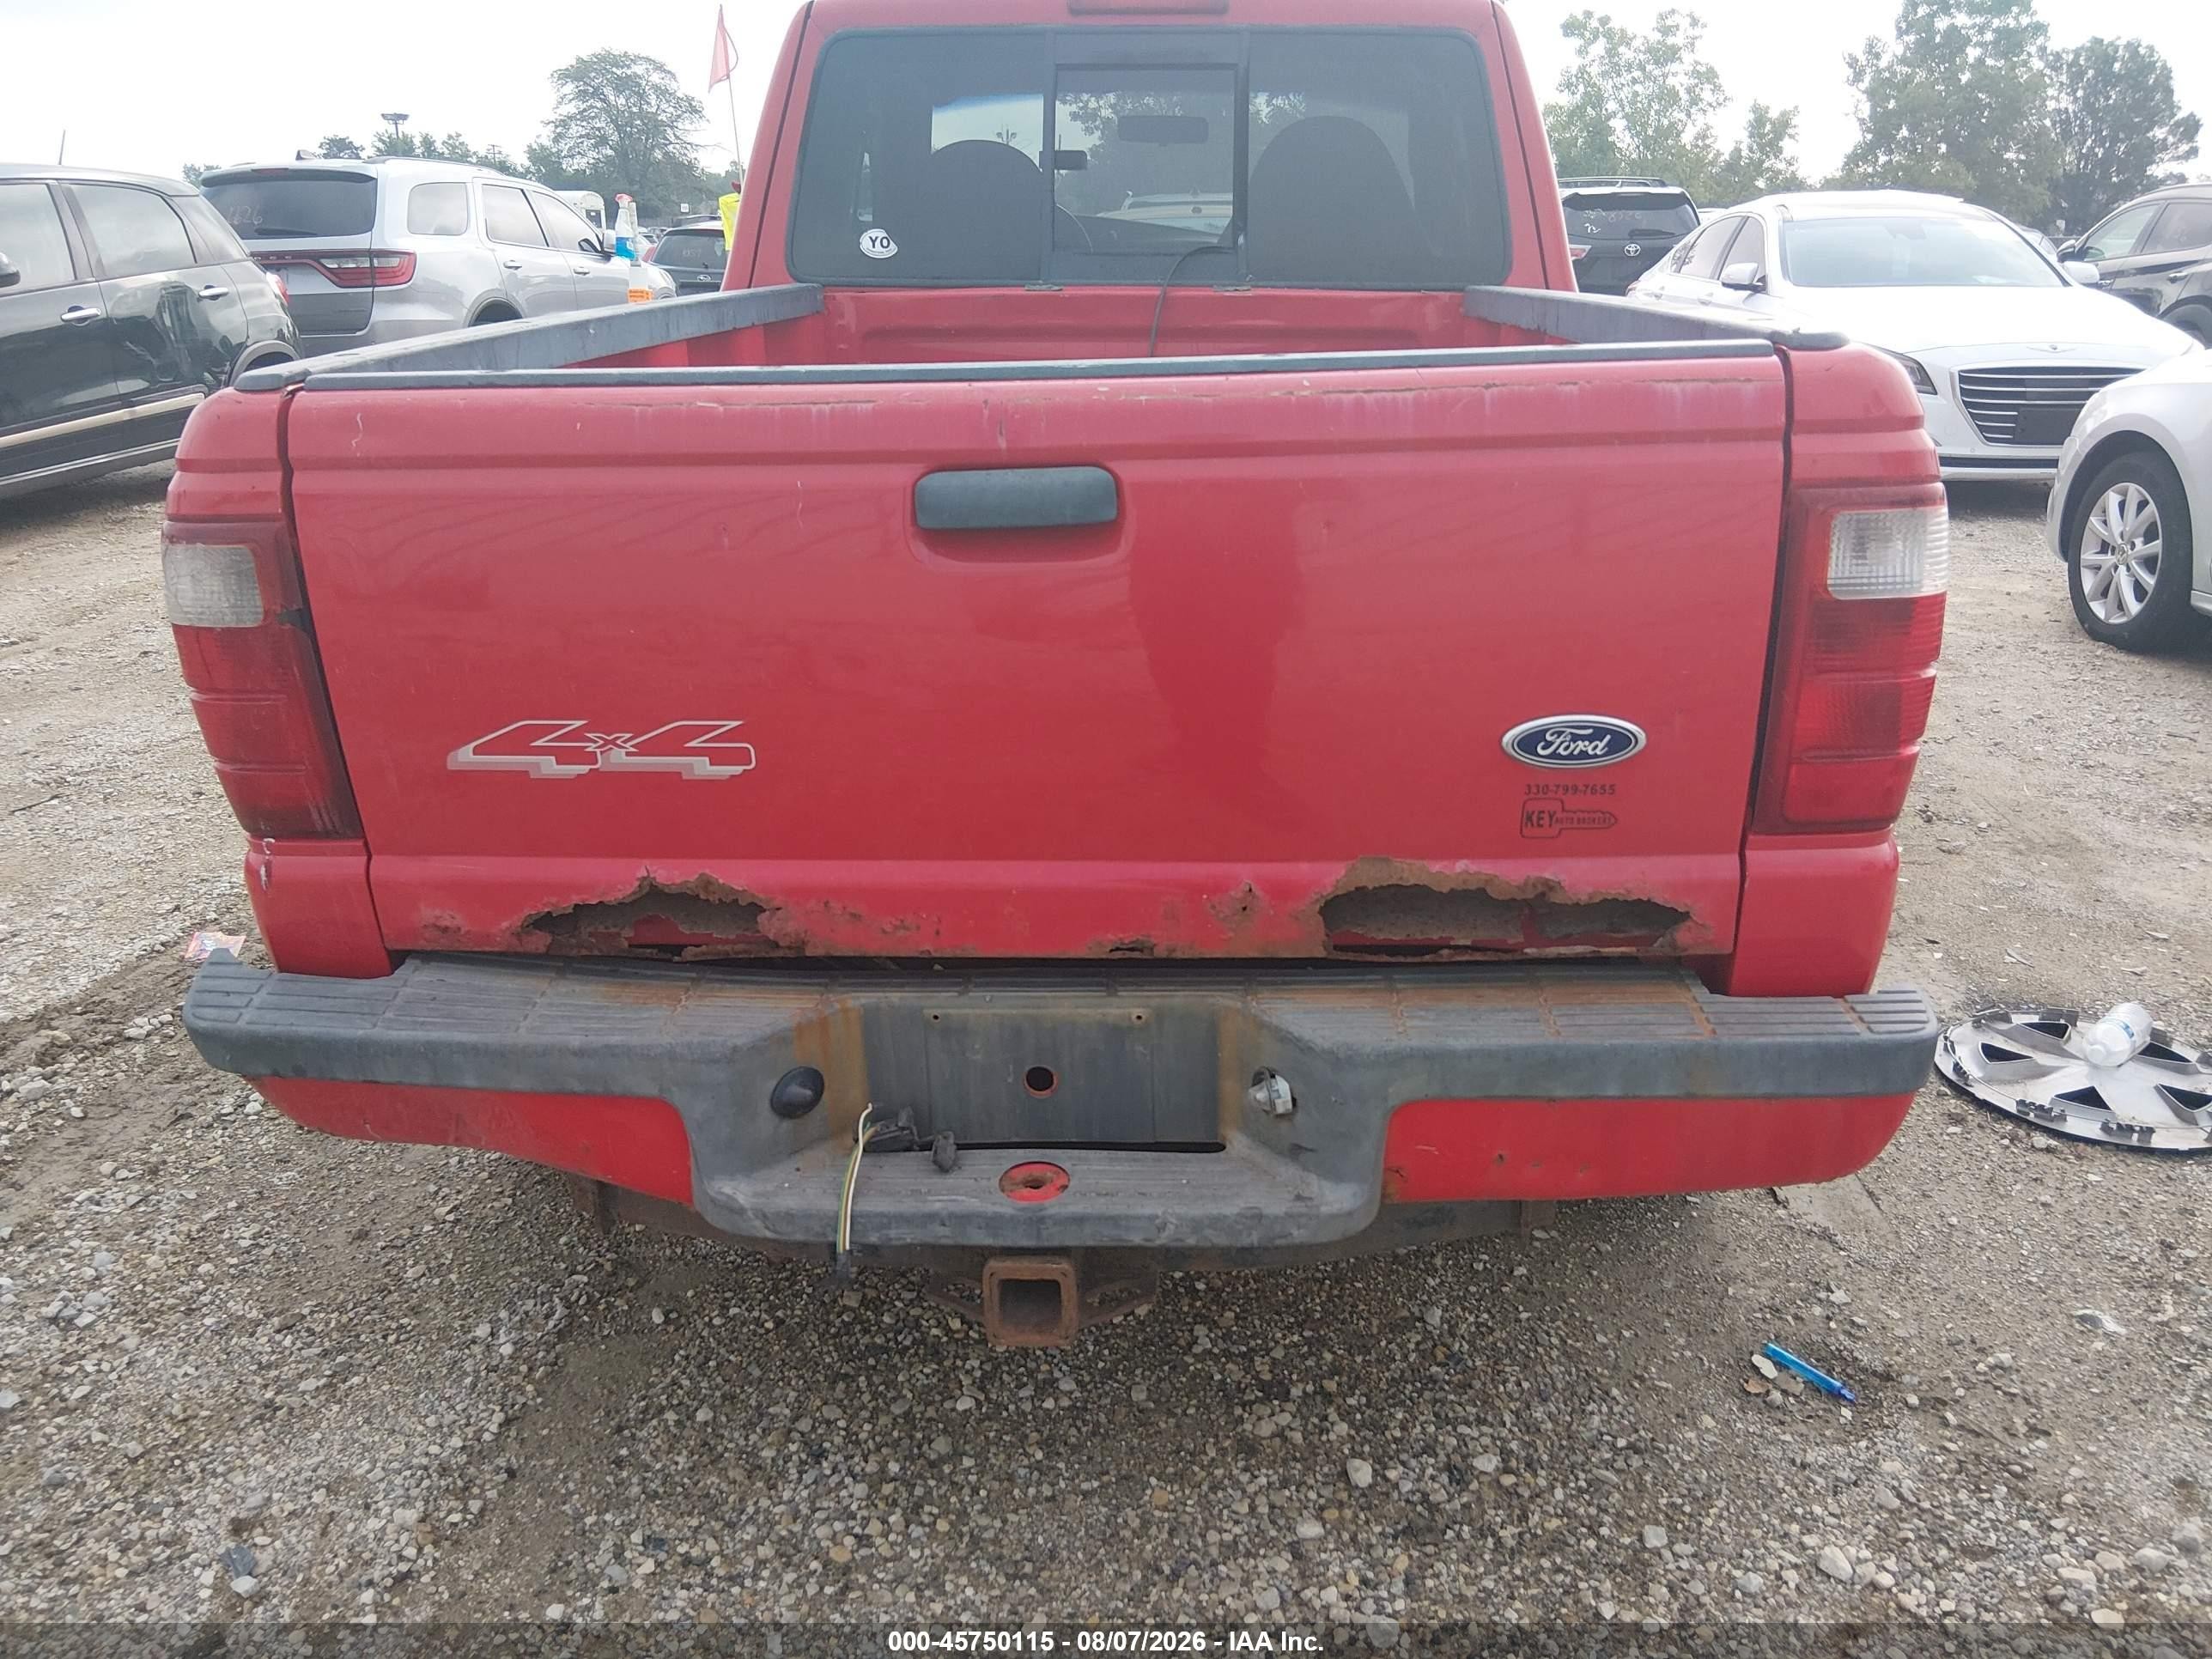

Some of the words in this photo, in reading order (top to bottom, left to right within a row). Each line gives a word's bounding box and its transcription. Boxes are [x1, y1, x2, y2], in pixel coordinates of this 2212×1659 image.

[867, 235, 891, 249] YO
[1536, 727, 1612, 756] Ford
[1524, 783, 1616, 796] 330-799-7655
[1524, 810, 1556, 829] KEY
